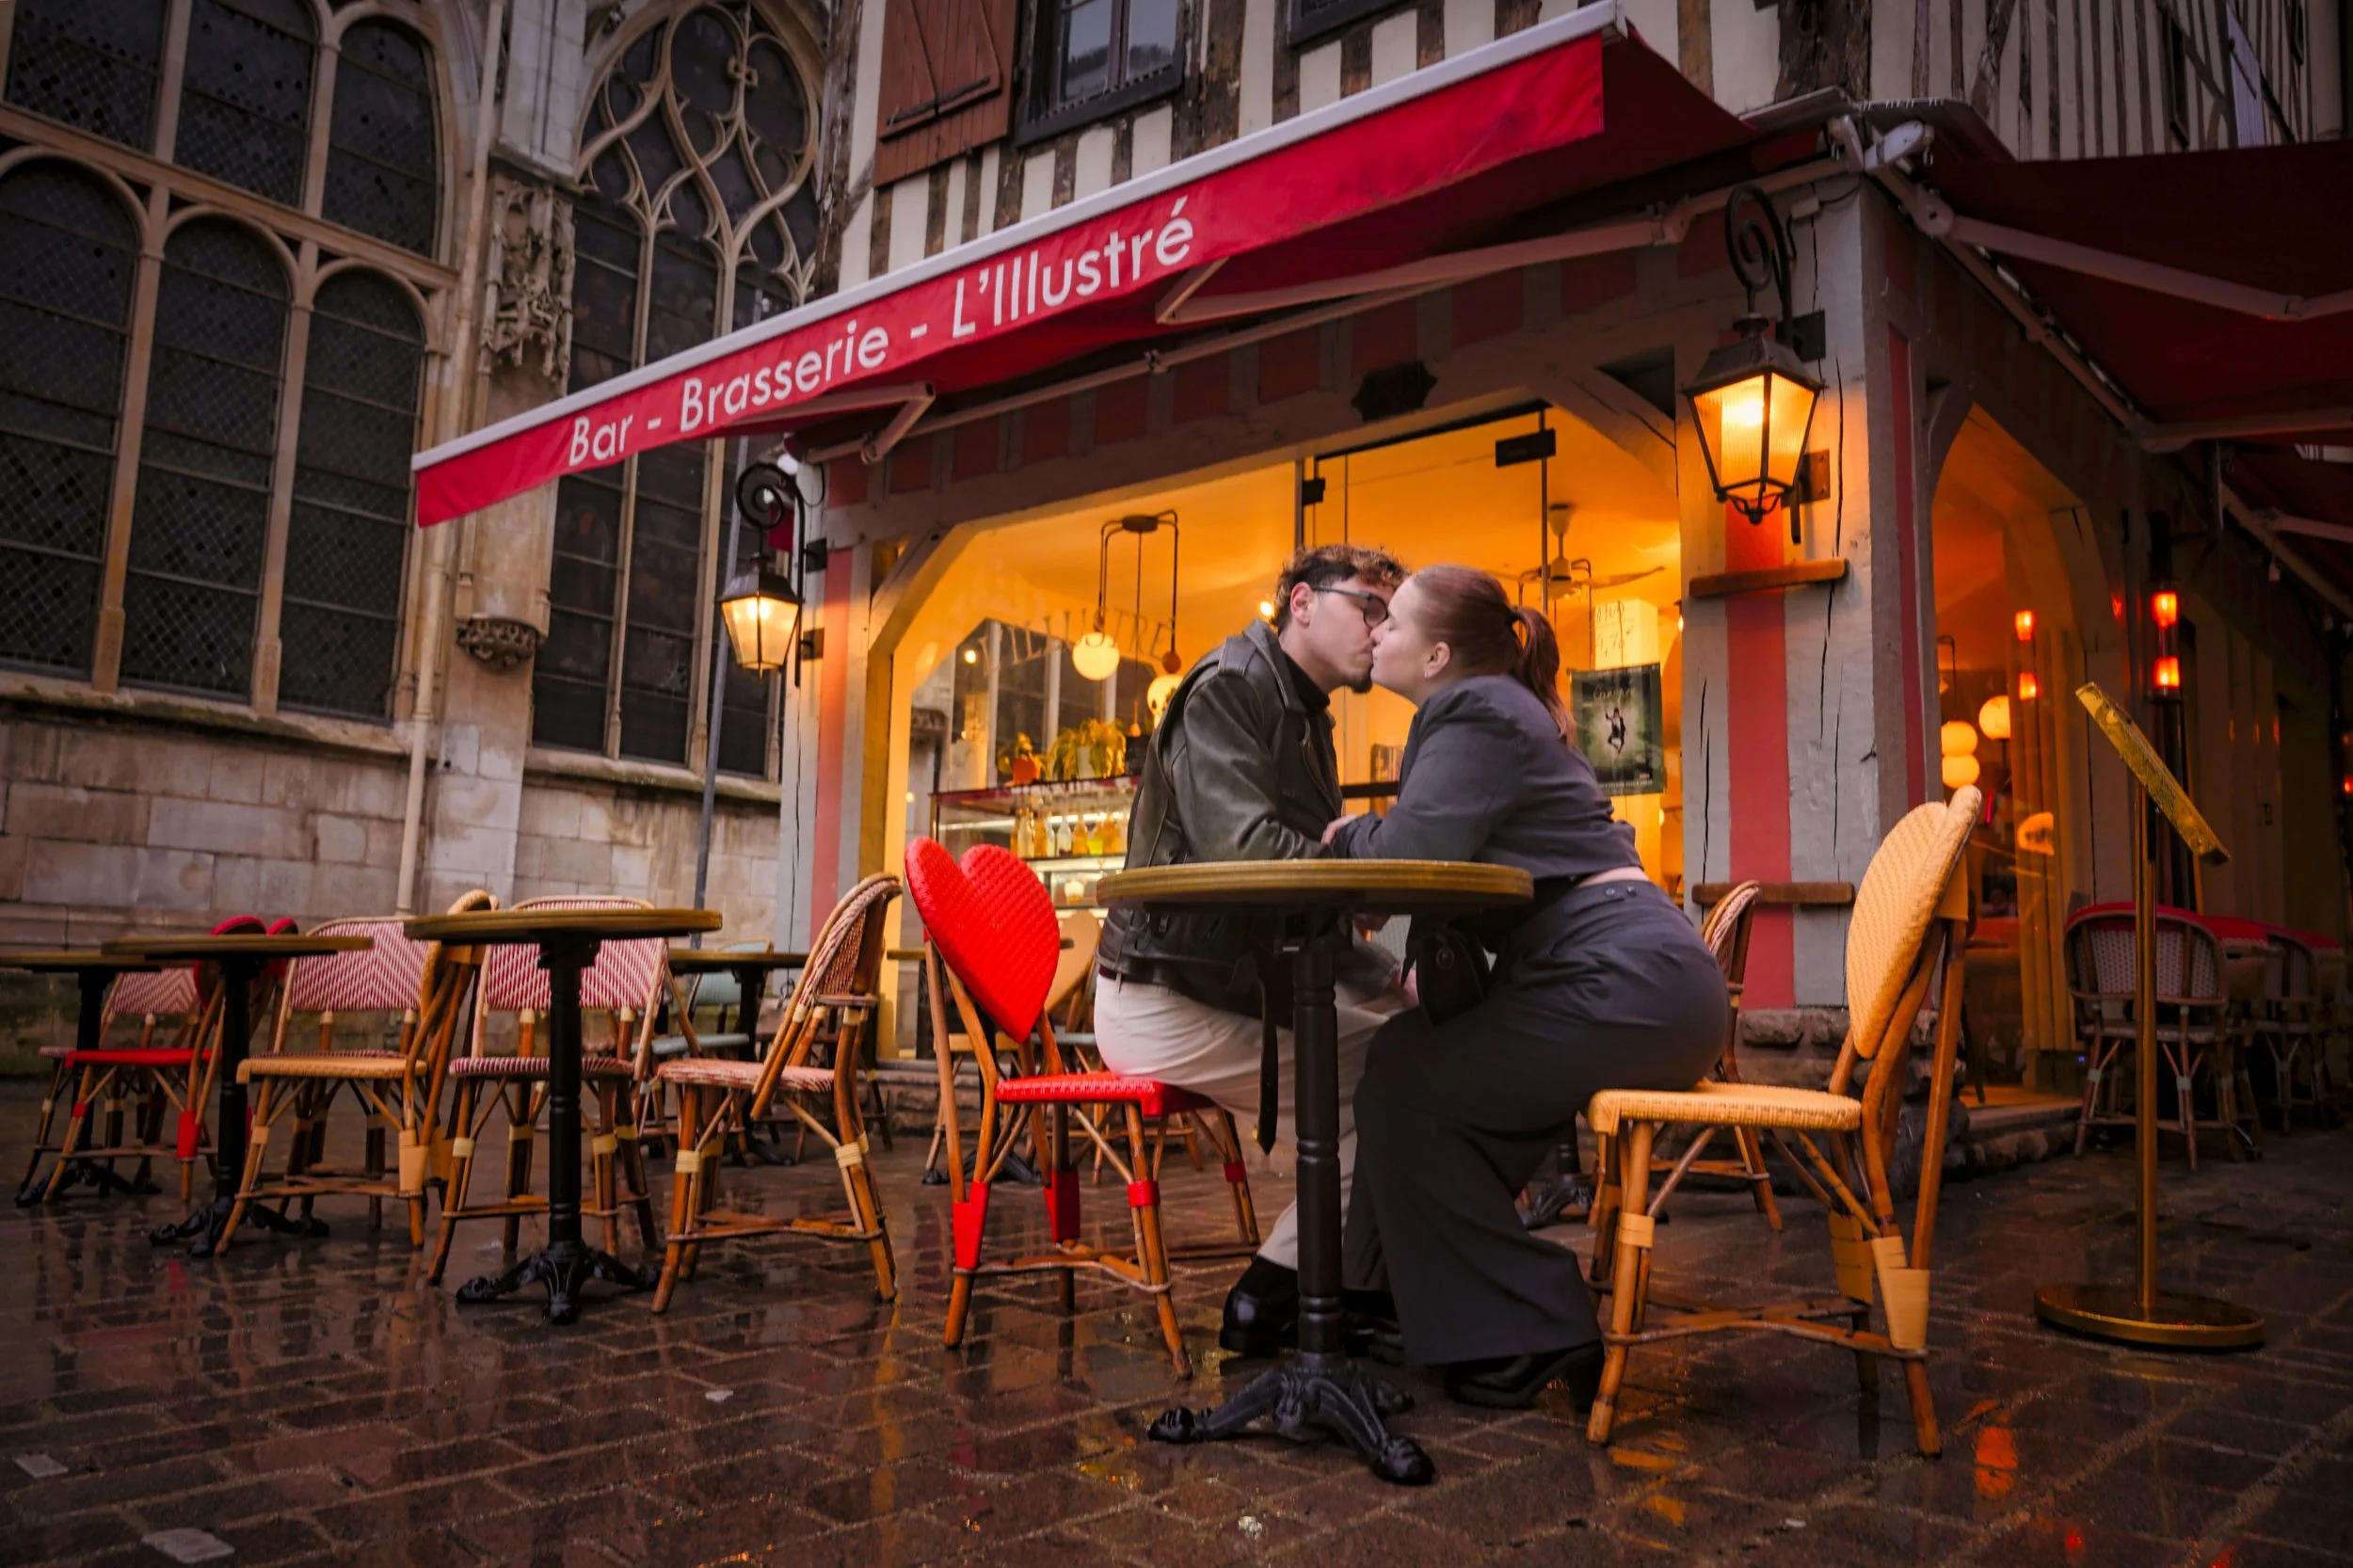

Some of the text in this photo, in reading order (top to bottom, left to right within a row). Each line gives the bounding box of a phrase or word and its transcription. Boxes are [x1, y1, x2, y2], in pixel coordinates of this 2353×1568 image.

[568, 415, 633, 467] Bar
[680, 320, 888, 432] Brasserie
[952, 196, 1193, 338] L'Illustré
